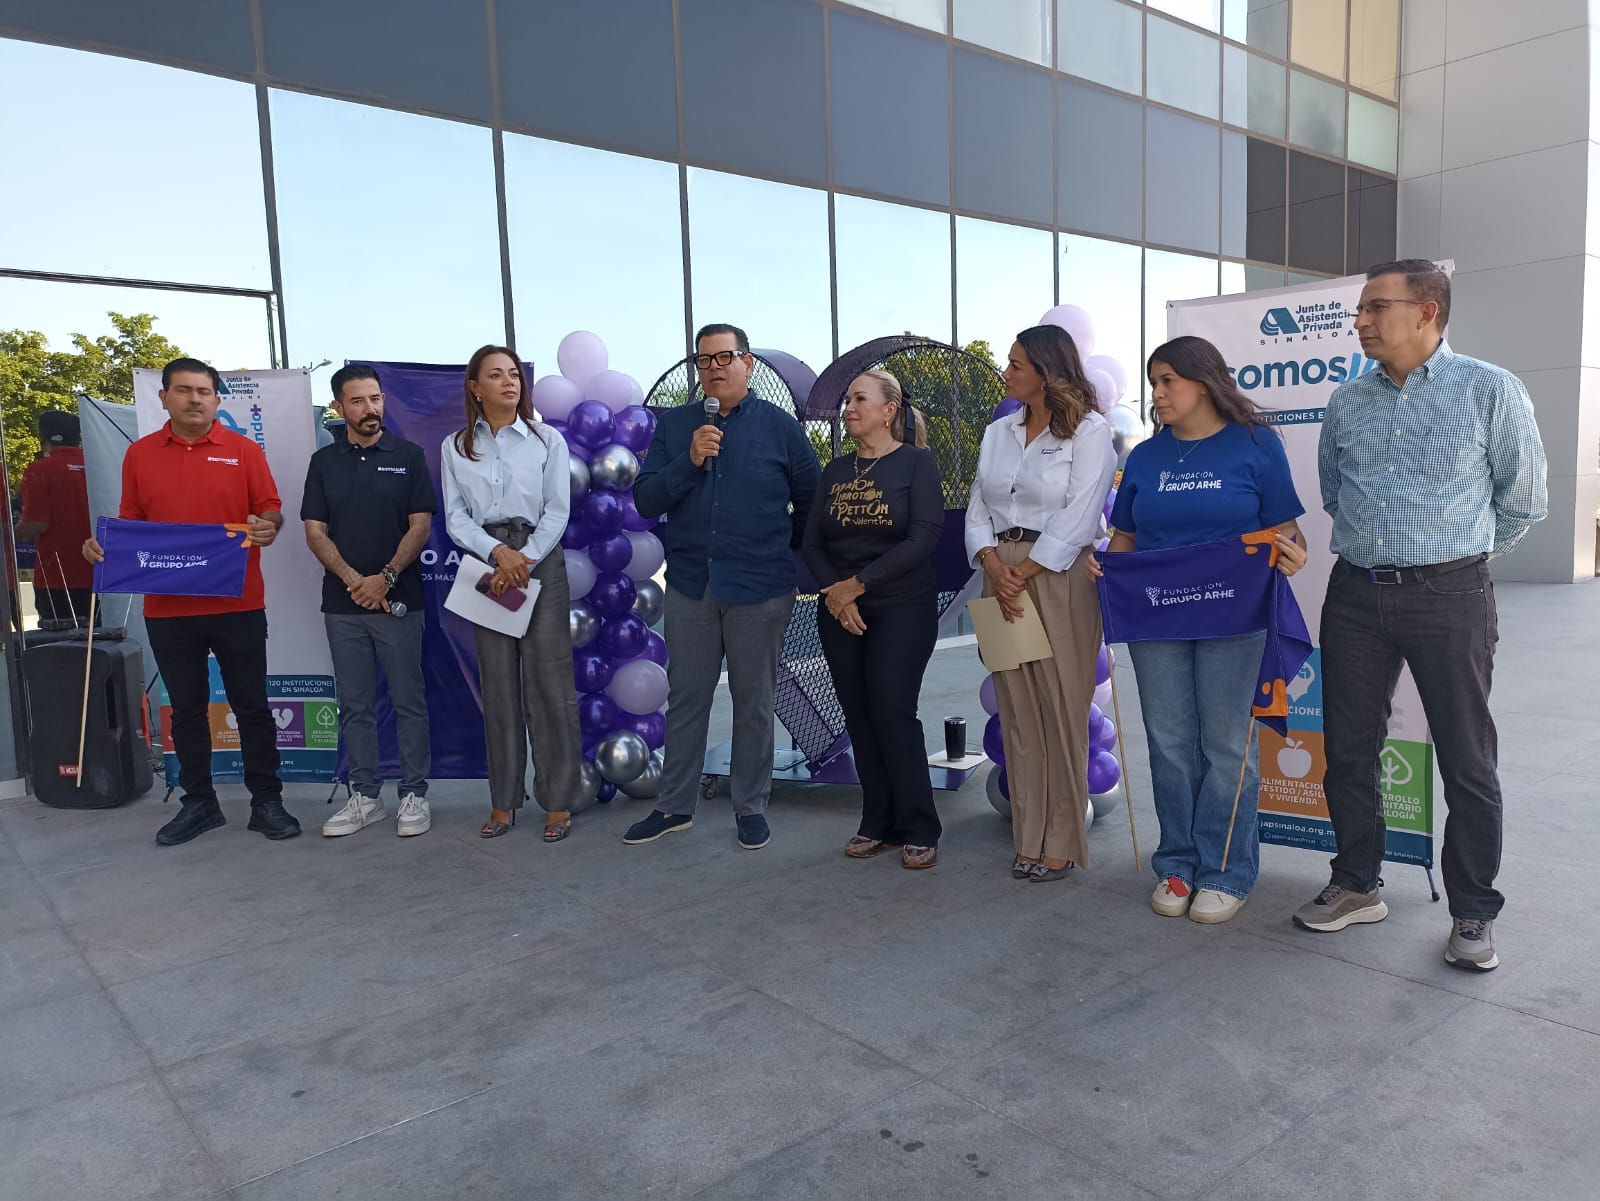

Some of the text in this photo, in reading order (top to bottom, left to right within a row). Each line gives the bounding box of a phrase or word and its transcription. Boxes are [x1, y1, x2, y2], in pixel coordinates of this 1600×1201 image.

[1295, 301, 1341, 314] Junta de
[1298, 311, 1351, 323] Asistenci
[1303, 320, 1343, 332] Privada
[1260, 330, 1354, 346] SINALOA
[1318, 411, 1325, 419] E
[1165, 482, 1196, 492] GRUPO
[852, 516, 893, 526] Valentina
[149, 561, 183, 569] GRUPO
[1161, 593, 1202, 606] GRUPO
[1276, 794, 1318, 806] VIVIENDA
[1382, 793, 1420, 805] RROLLO
[1383, 802, 1422, 813] NITARIO
